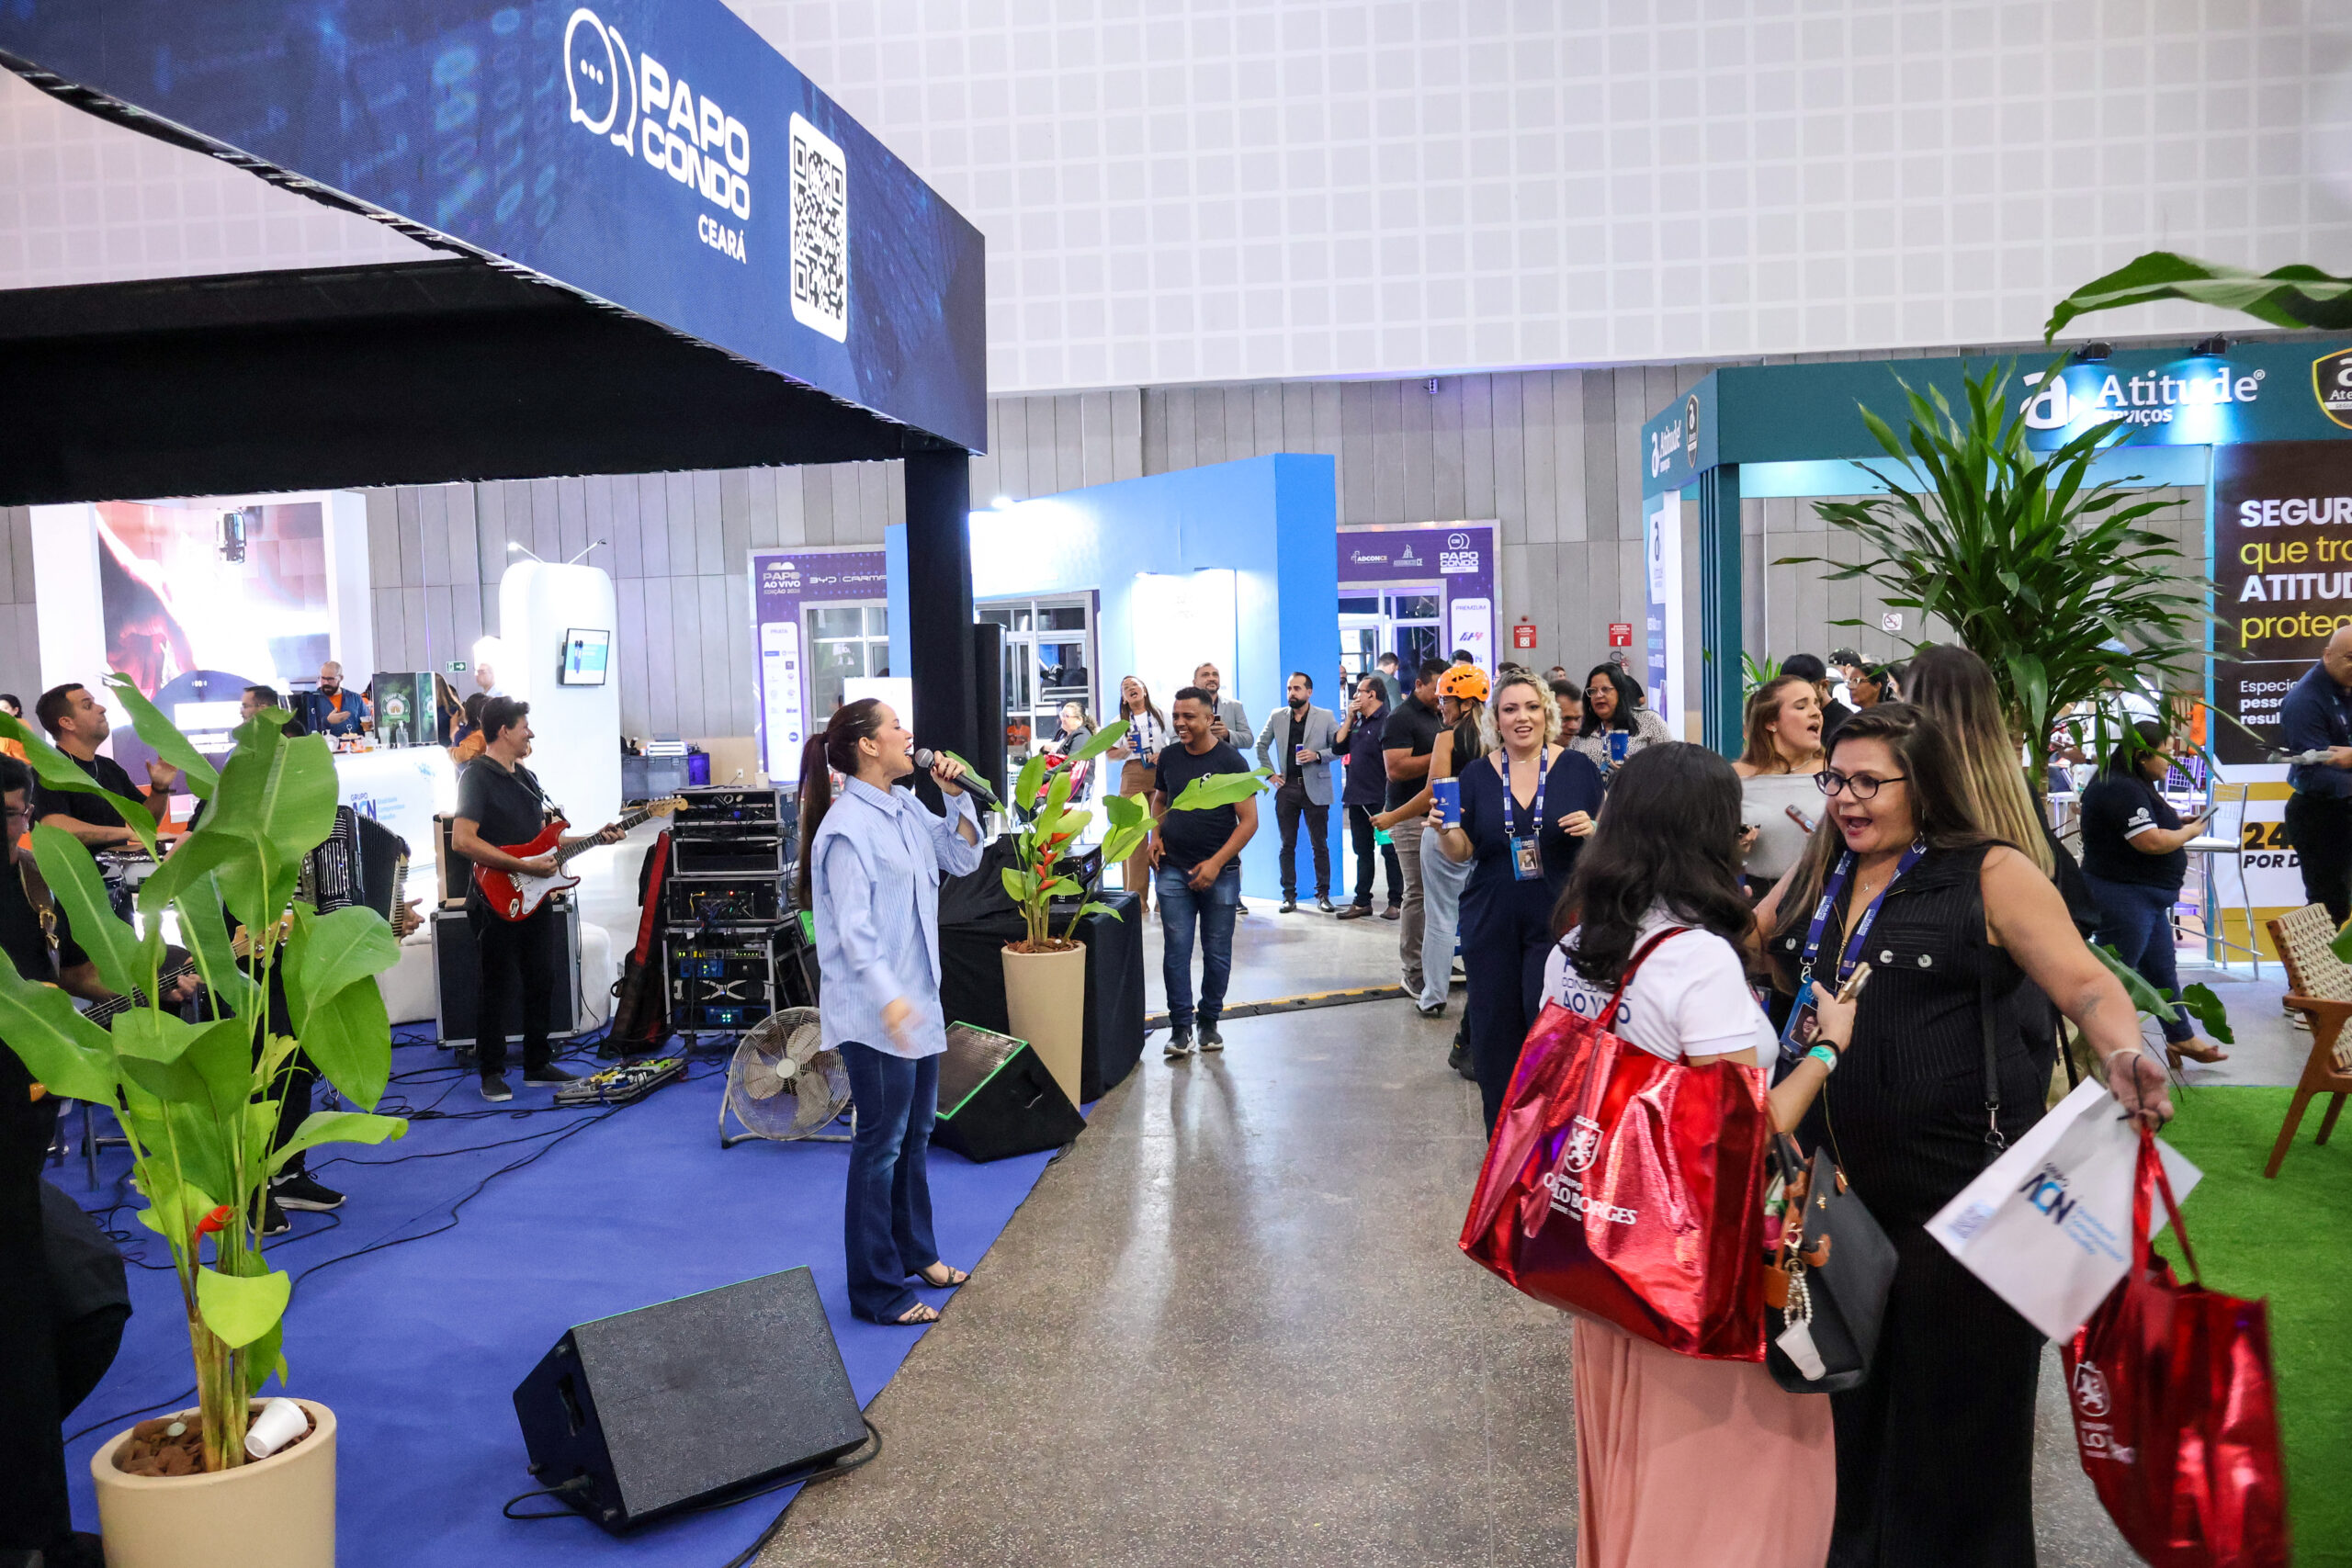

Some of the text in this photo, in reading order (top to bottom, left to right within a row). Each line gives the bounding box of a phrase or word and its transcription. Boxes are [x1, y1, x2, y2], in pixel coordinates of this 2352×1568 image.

[641, 52, 750, 176] PAPO
[641, 118, 751, 221] CONDO
[698, 214, 747, 265] CEARÁ
[2239, 497, 2352, 527] SEGUR
[1440, 551, 1478, 560] PAPO
[1440, 558, 1478, 567] CONDO
[2240, 541, 2308, 573] que
[763, 572, 800, 581] PAPO
[778, 580, 801, 588] VIVO
[2243, 854, 2285, 869] POR
[1564, 990, 1587, 1014] AO
[1570, 1191, 1638, 1225] BORGES
